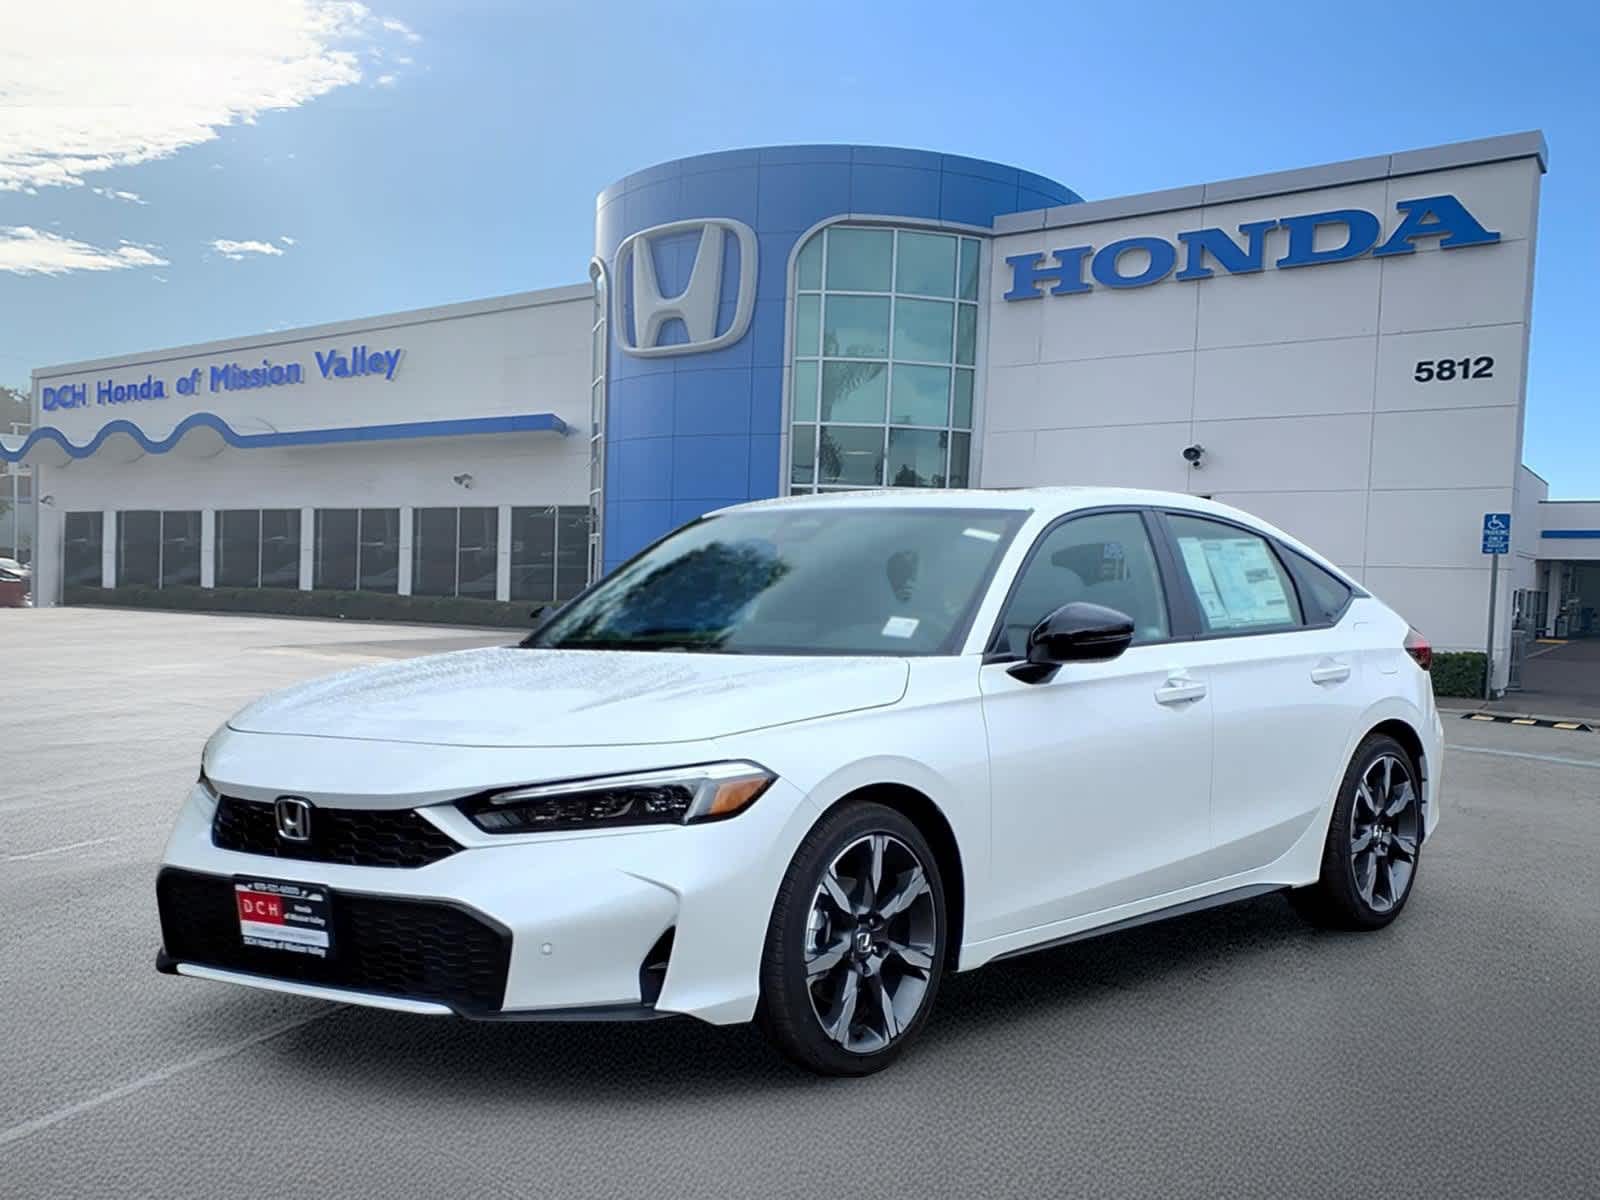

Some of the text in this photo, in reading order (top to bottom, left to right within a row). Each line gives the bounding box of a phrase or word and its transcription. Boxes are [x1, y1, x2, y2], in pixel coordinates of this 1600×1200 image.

[1004, 194, 1501, 301] HONDA
[42, 345, 403, 411] DCH Honda of Mission Valley
[1414, 355, 1495, 382] 5812
[243, 898, 280, 917] DCH
